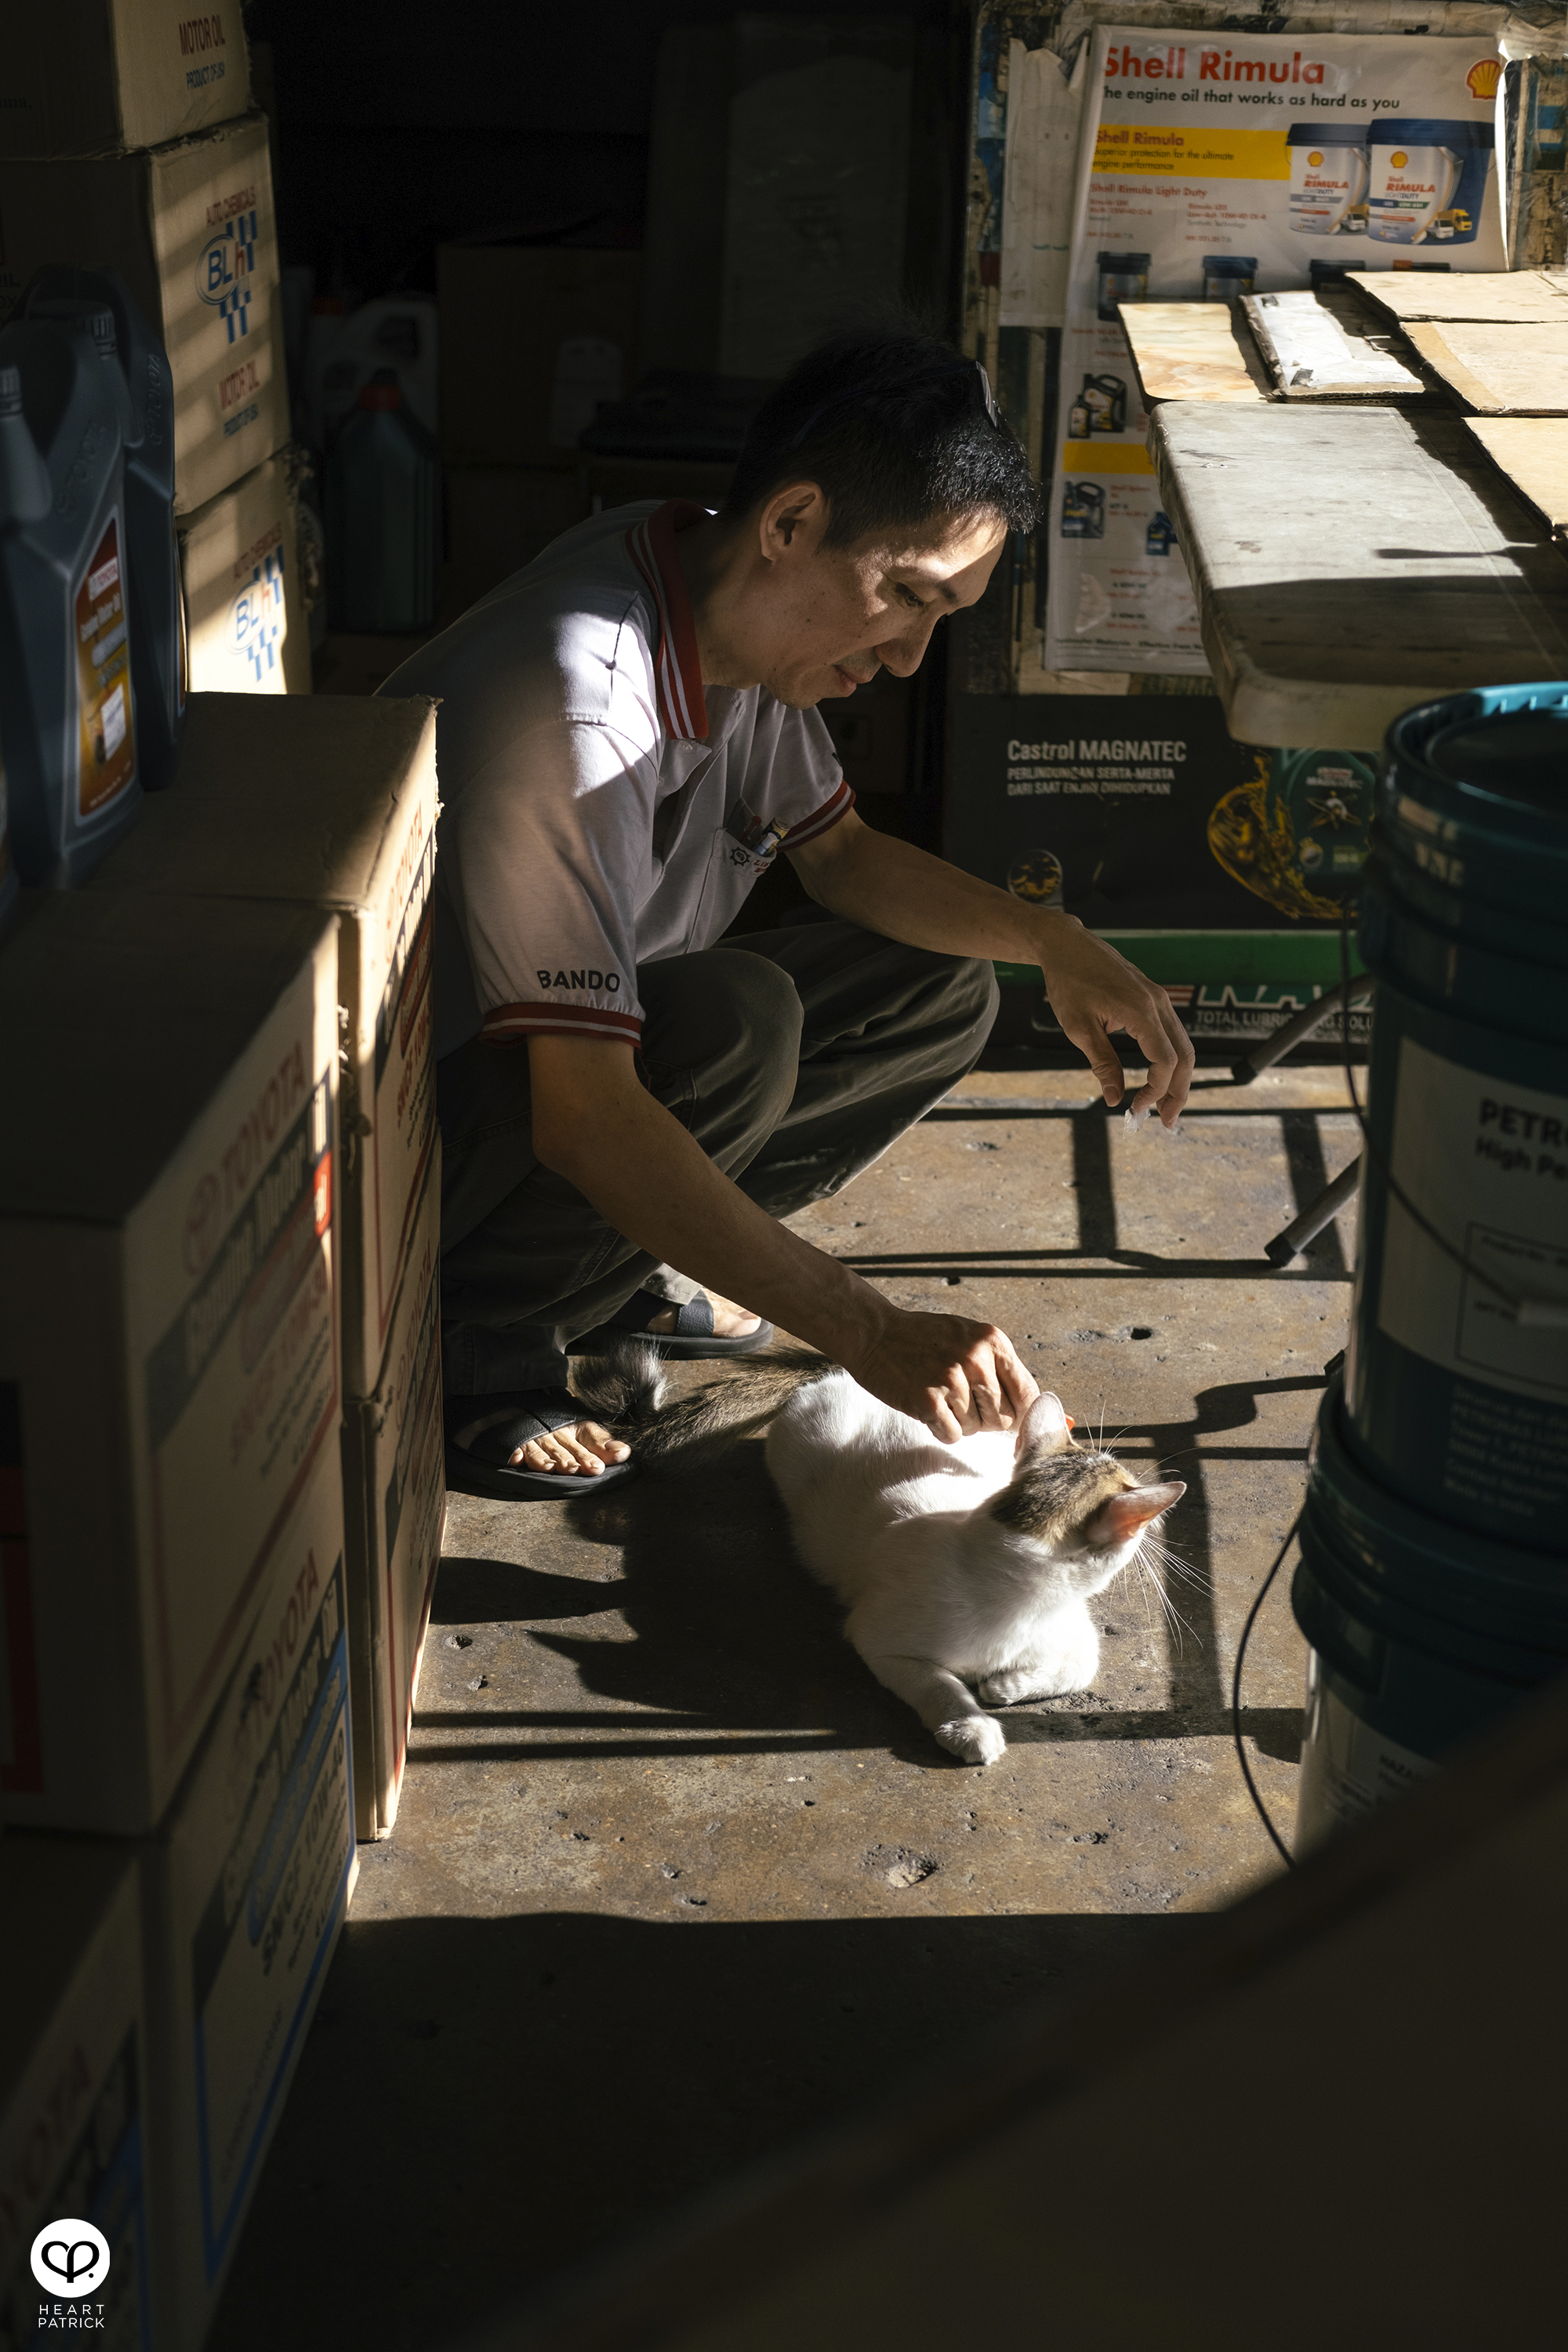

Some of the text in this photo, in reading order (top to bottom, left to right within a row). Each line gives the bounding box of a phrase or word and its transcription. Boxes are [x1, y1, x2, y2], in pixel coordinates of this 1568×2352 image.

[179, 14, 226, 56] MOTOR OIL
[1105, 45, 1325, 85] Shell Rimula
[1104, 85, 1400, 111] he engine oil that works as hard as you
[1096, 130, 1185, 147] Shell Rimula
[1094, 147, 1235, 161] Superior protection for the ultimate
[1092, 161, 1174, 171] engine performance
[1090, 183, 1207, 198] Shell Rimula Light Duty
[1304, 180, 1348, 189] RIMULA
[1386, 183, 1436, 193] RIMULA
[1007, 739, 1187, 762] Castrol MAGNATEC
[1007, 766, 1175, 781] PERLINDUNGAN SERTA-MERTA
[1007, 782, 1033, 797] DARI
[1035, 781, 1061, 794] SAAT
[1062, 781, 1098, 794] ENJIN
[537, 970, 620, 993] BANDO
[1196, 1010, 1236, 1024] TOTAL
[221, 1040, 307, 1212] TOYOTA
[1480, 1098, 1568, 1148] PETR
[1475, 1134, 1531, 1171] High
[252, 1548, 319, 1740] TOYOTA
